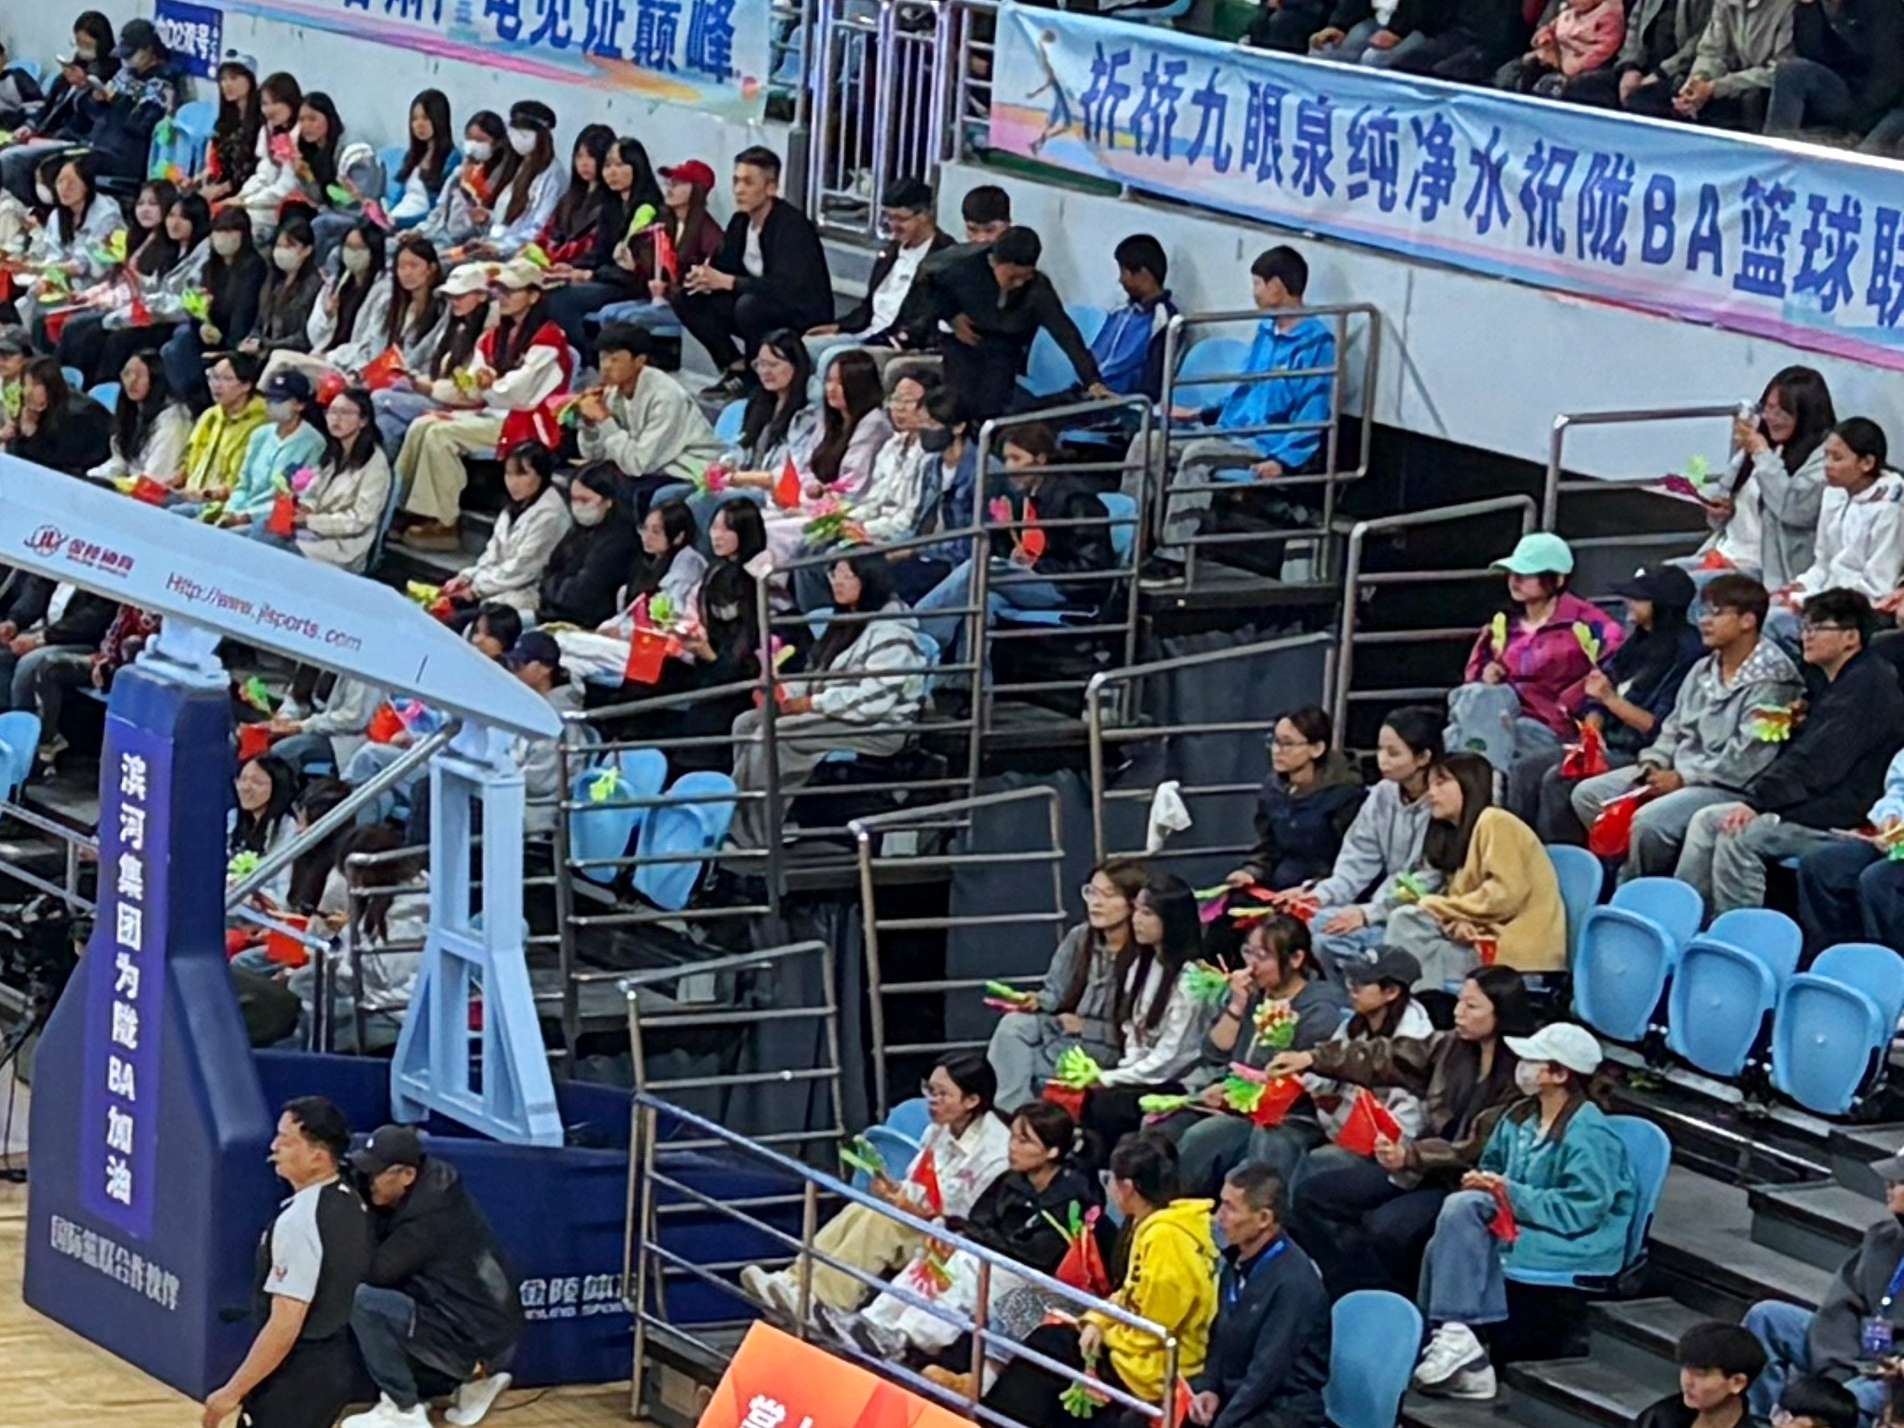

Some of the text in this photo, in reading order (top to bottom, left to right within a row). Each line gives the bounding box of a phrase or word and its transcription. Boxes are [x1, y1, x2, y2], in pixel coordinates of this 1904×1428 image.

[105, 751, 145, 1206] 滨河集团为陇BA加油
